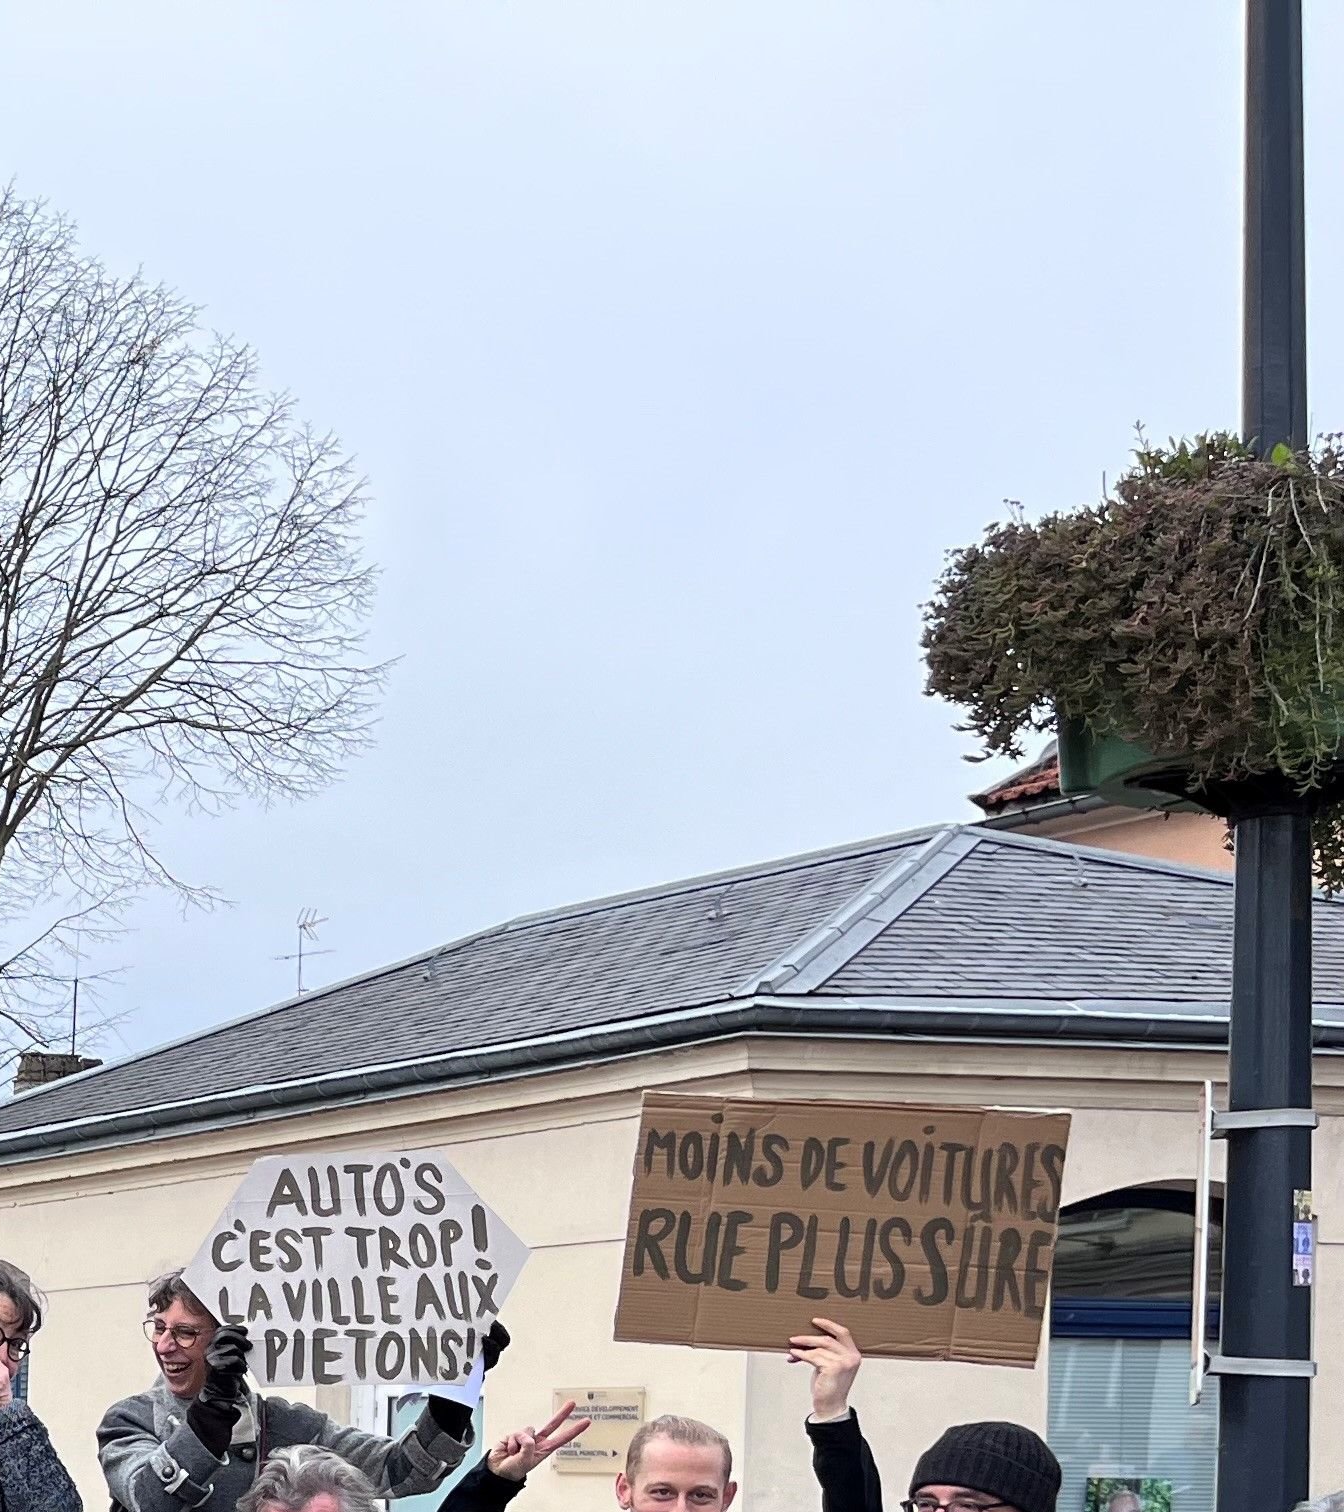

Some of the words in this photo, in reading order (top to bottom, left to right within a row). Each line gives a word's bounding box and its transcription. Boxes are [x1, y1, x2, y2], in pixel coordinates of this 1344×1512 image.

[644, 1112, 789, 1188] MOINS
[800, 1136, 850, 1192] DE
[863, 1125, 1066, 1223] VOITURES
[212, 1218, 334, 1272] C'EST
[633, 1208, 754, 1292] RUE
[765, 1212, 912, 1302] PLUS
[218, 1283, 273, 1324] LA
[282, 1275, 402, 1325] VILLE
[414, 1270, 499, 1324] AUX
